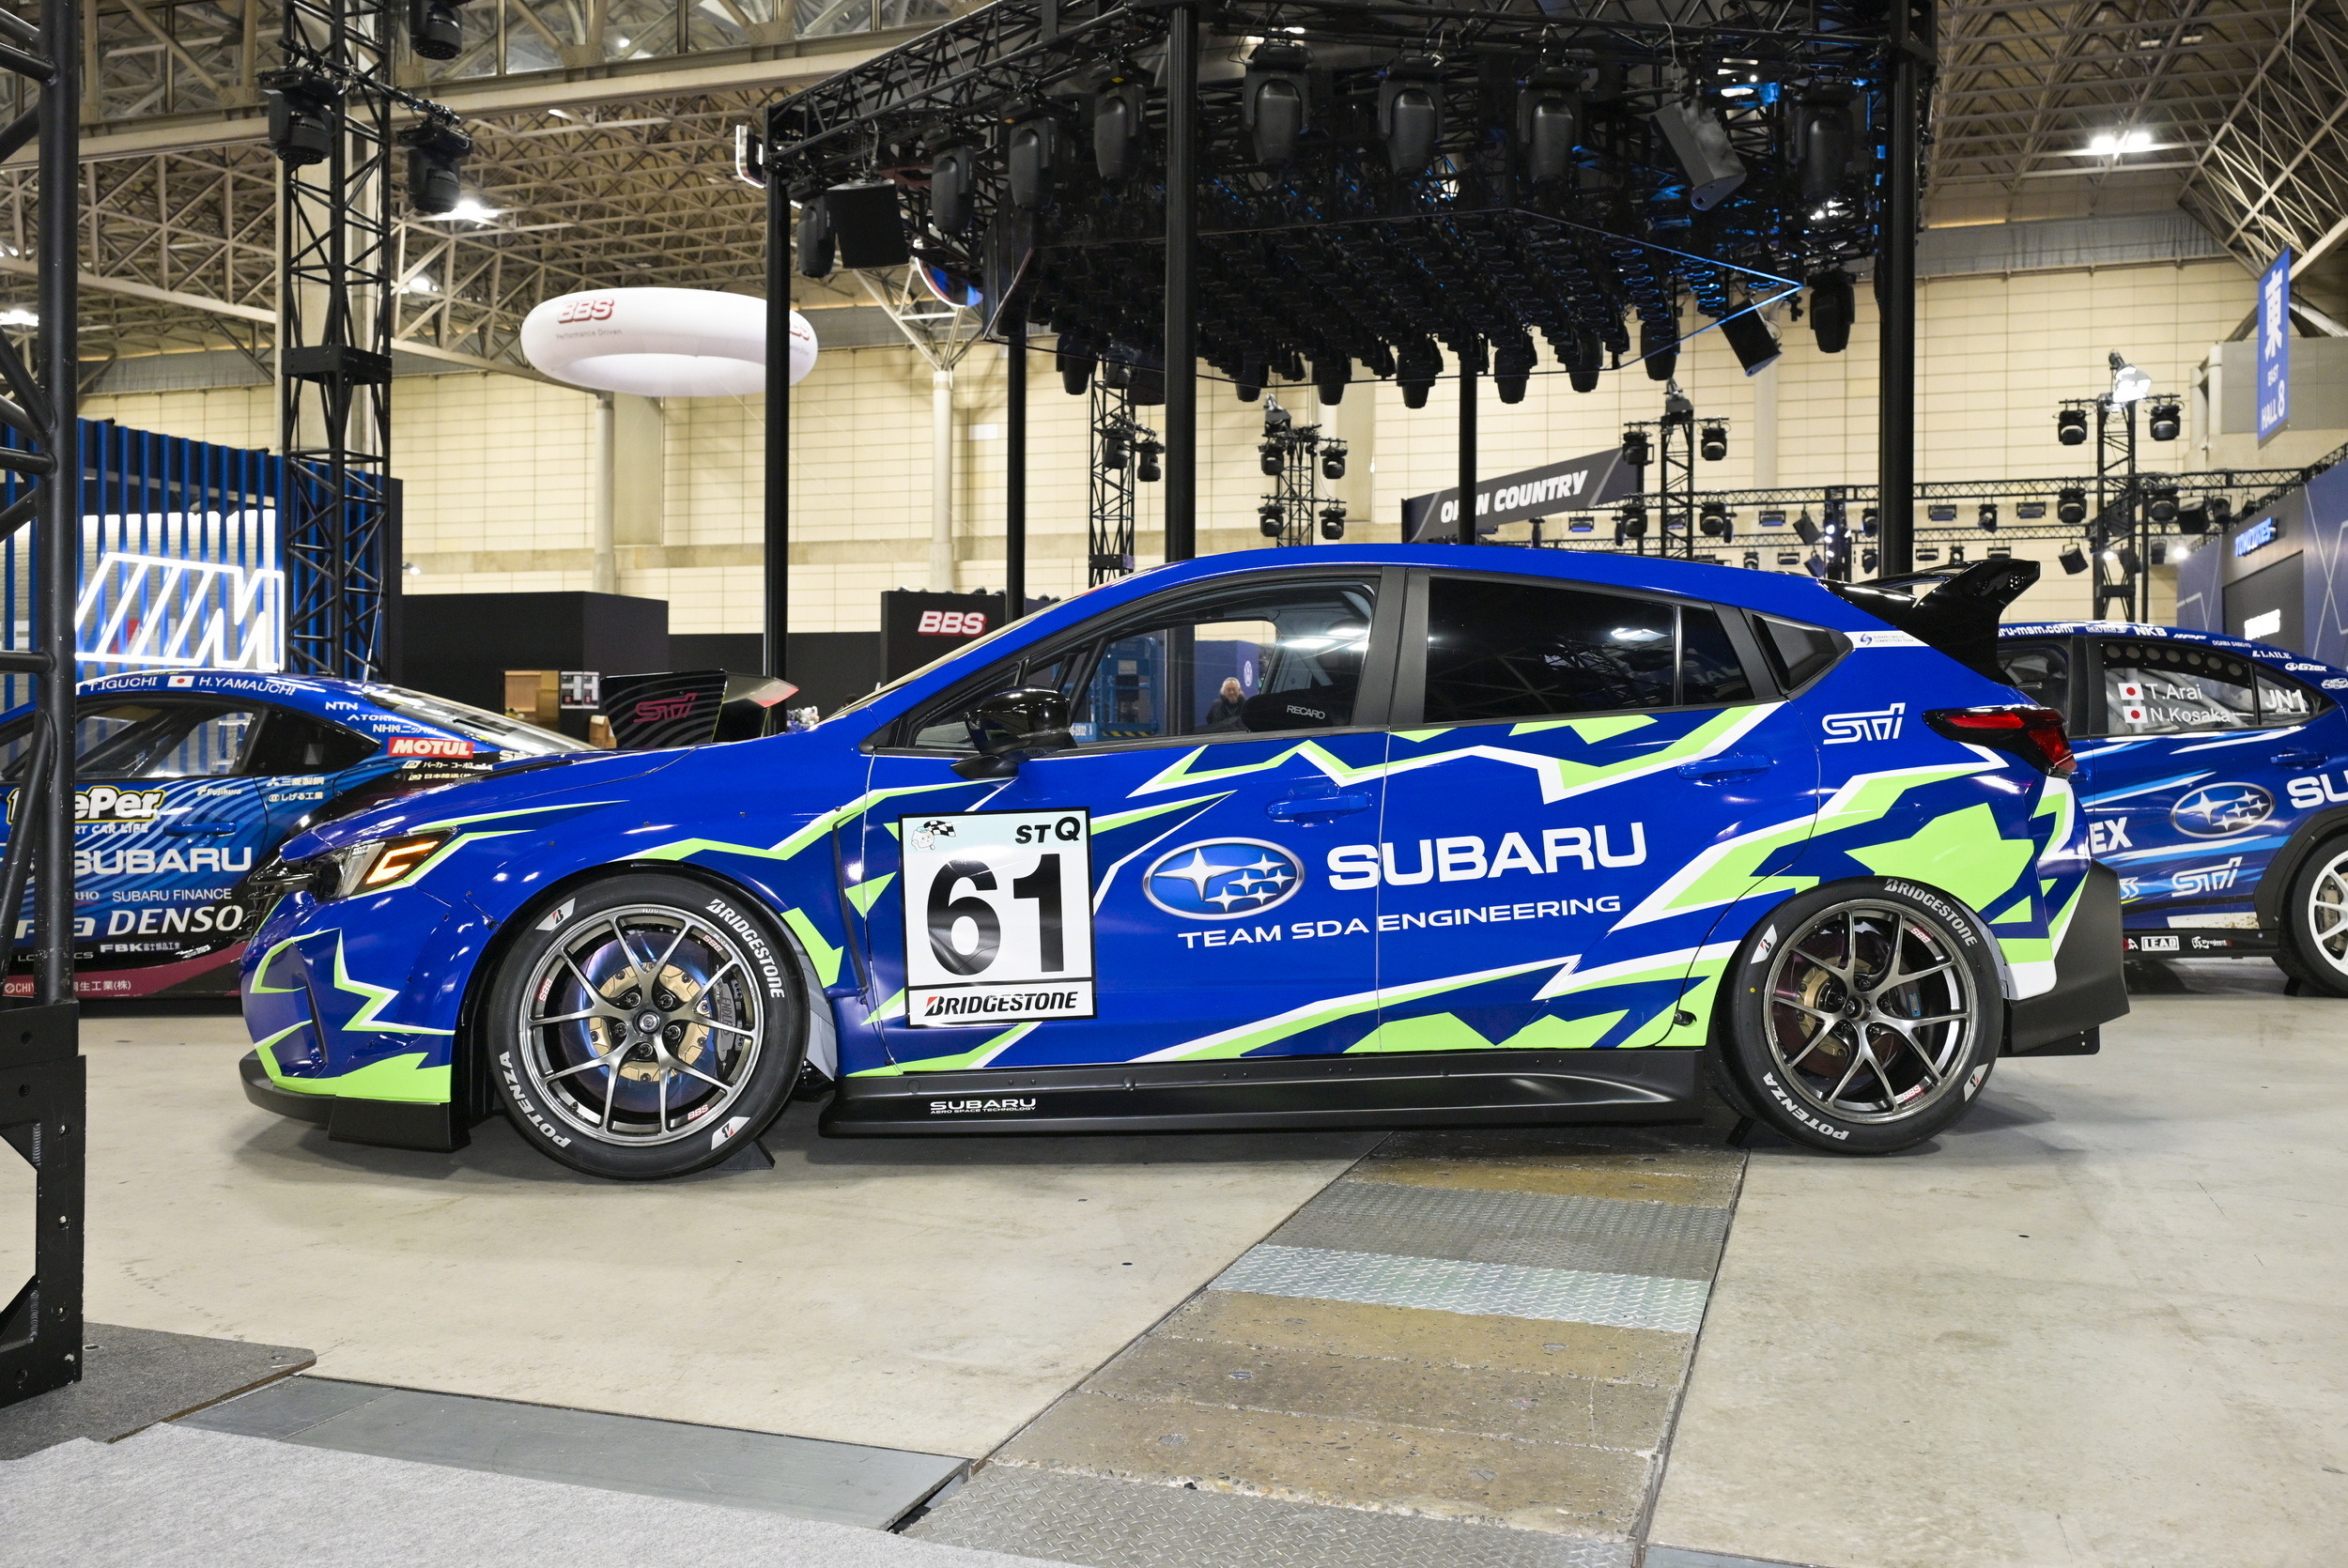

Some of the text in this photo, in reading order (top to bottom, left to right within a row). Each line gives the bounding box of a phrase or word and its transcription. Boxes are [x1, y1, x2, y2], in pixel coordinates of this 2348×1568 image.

[558, 298, 613, 324] BBS
[2264, 271, 2284, 363] 東
[2262, 379, 2285, 432] HALL 8
[1440, 469, 1588, 523] OPN COUNTRY
[918, 610, 987, 636] BBS
[2134, 625, 2167, 638] NKB
[2260, 651, 2292, 659] LAILE
[87, 676, 296, 696] T.IGUCHI H.YAMAUCHI
[2146, 684, 2202, 700] T.Arai
[325, 701, 358, 711] NTN
[1287, 704, 1326, 720] RECARO
[2265, 688, 2307, 714] JN1
[2150, 707, 2232, 723] N.Kosaka
[392, 739, 471, 756] MOTUL
[92, 825, 116, 834] CAR
[120, 823, 148, 834] LIFE
[74, 847, 252, 874] SUBARU
[1326, 822, 1647, 891] SUBARU
[113, 888, 232, 902] SUBARU FINANCE
[107, 904, 244, 936] DENSO
[927, 853, 1064, 976] 61
[1178, 895, 1622, 949] TEAM SDA ENGINEERING
[1884, 878, 1977, 946] BRIDGESTONE
[1910, 927, 1931, 943] BBS
[2145, 939, 2175, 947] LEAD
[100, 943, 143, 953] FBK
[705, 899, 785, 999] BRIDGESTONE
[538, 977, 554, 1002] BBS
[924, 991, 1078, 1017] BRIDGESTONE
[499, 1051, 571, 1148] POTENZA
[1902, 1084, 1922, 1099] BBS
[687, 1103, 710, 1121] BBS
[930, 1099, 1036, 1111] SUBARU
[1762, 1070, 1849, 1141] POTENZA
